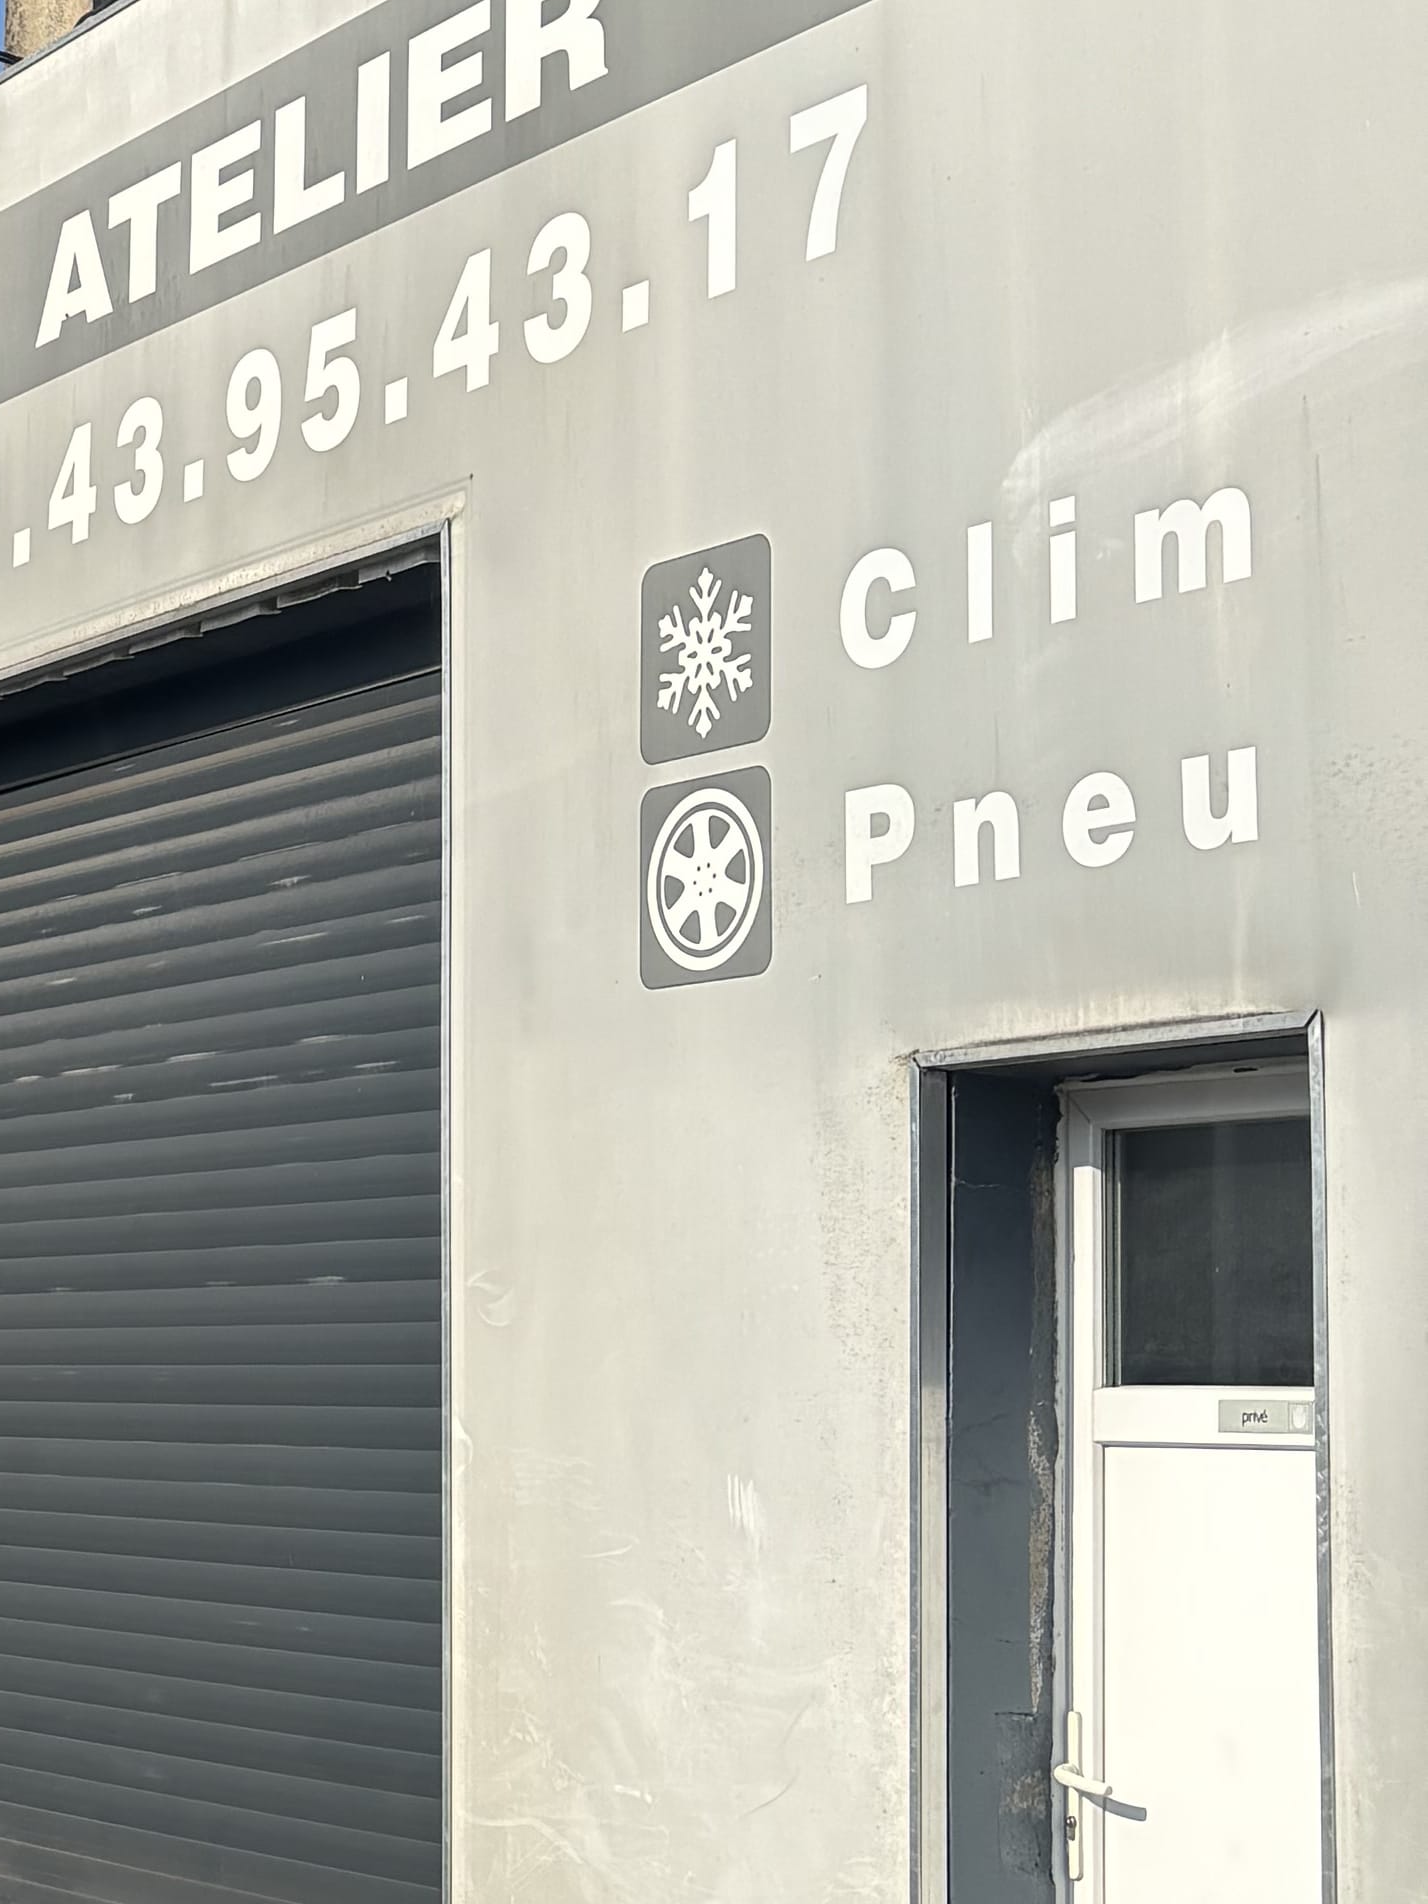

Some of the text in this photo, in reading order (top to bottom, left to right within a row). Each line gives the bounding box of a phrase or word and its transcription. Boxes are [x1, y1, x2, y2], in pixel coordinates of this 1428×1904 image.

[839, 486, 1252, 670] Clim
[844, 745, 1259, 905] Pneu
[1241, 1409, 1269, 1428] privé
